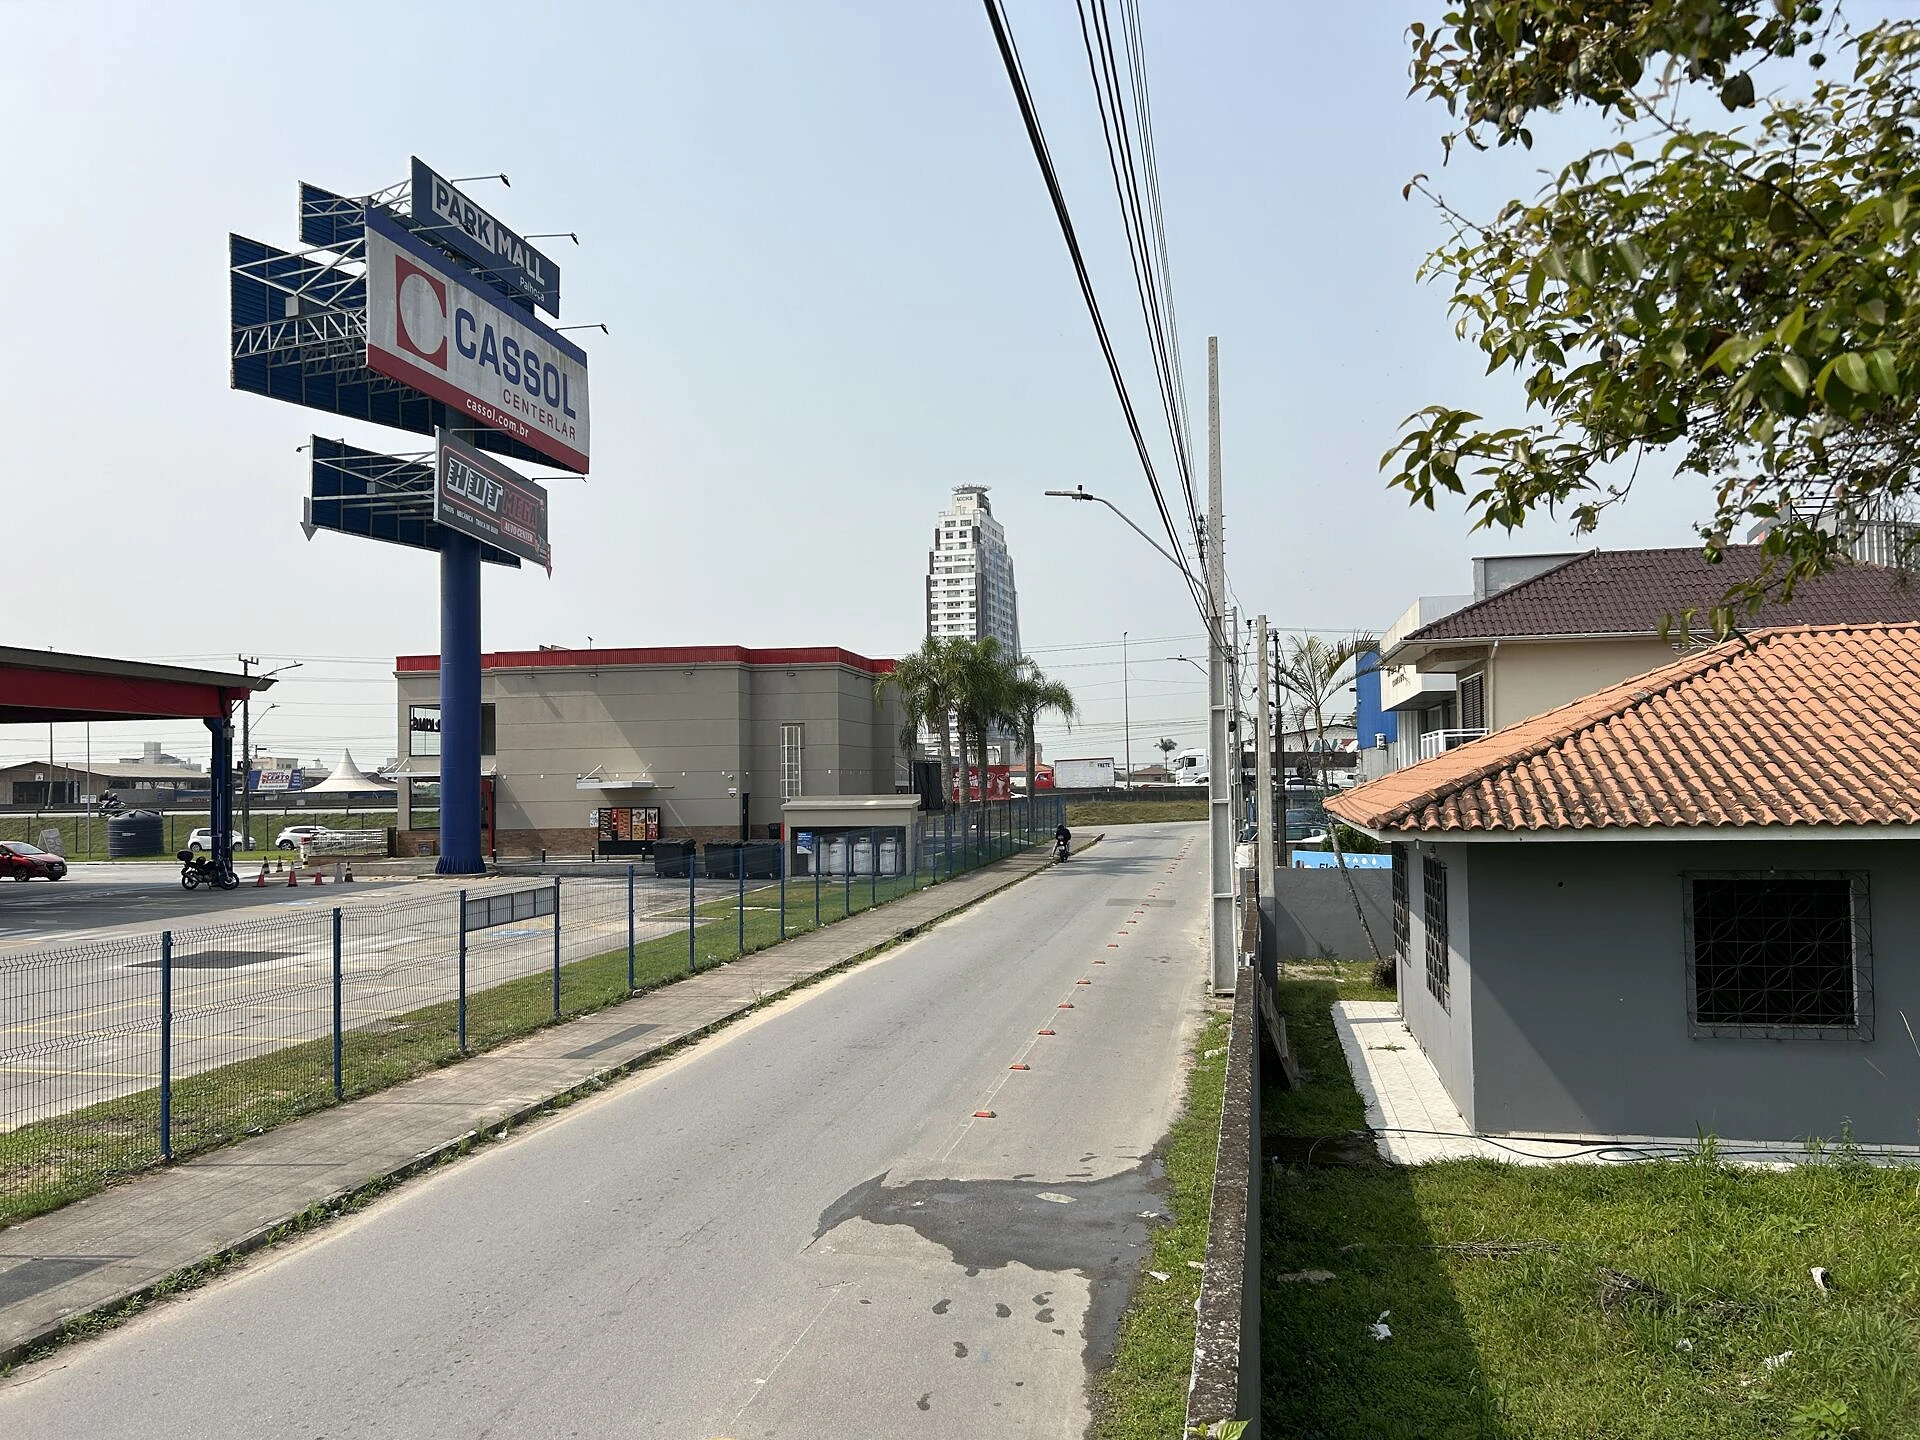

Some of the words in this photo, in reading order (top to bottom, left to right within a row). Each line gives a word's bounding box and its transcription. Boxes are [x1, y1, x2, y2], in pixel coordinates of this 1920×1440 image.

[436, 181, 491, 247] PARK
[498, 229, 544, 286] MALL
[520, 277, 544, 302] Palhoça
[455, 307, 576, 420] CASSOL
[466, 398, 529, 438] cassol.com.br
[503, 388, 576, 441] CENTERLAR
